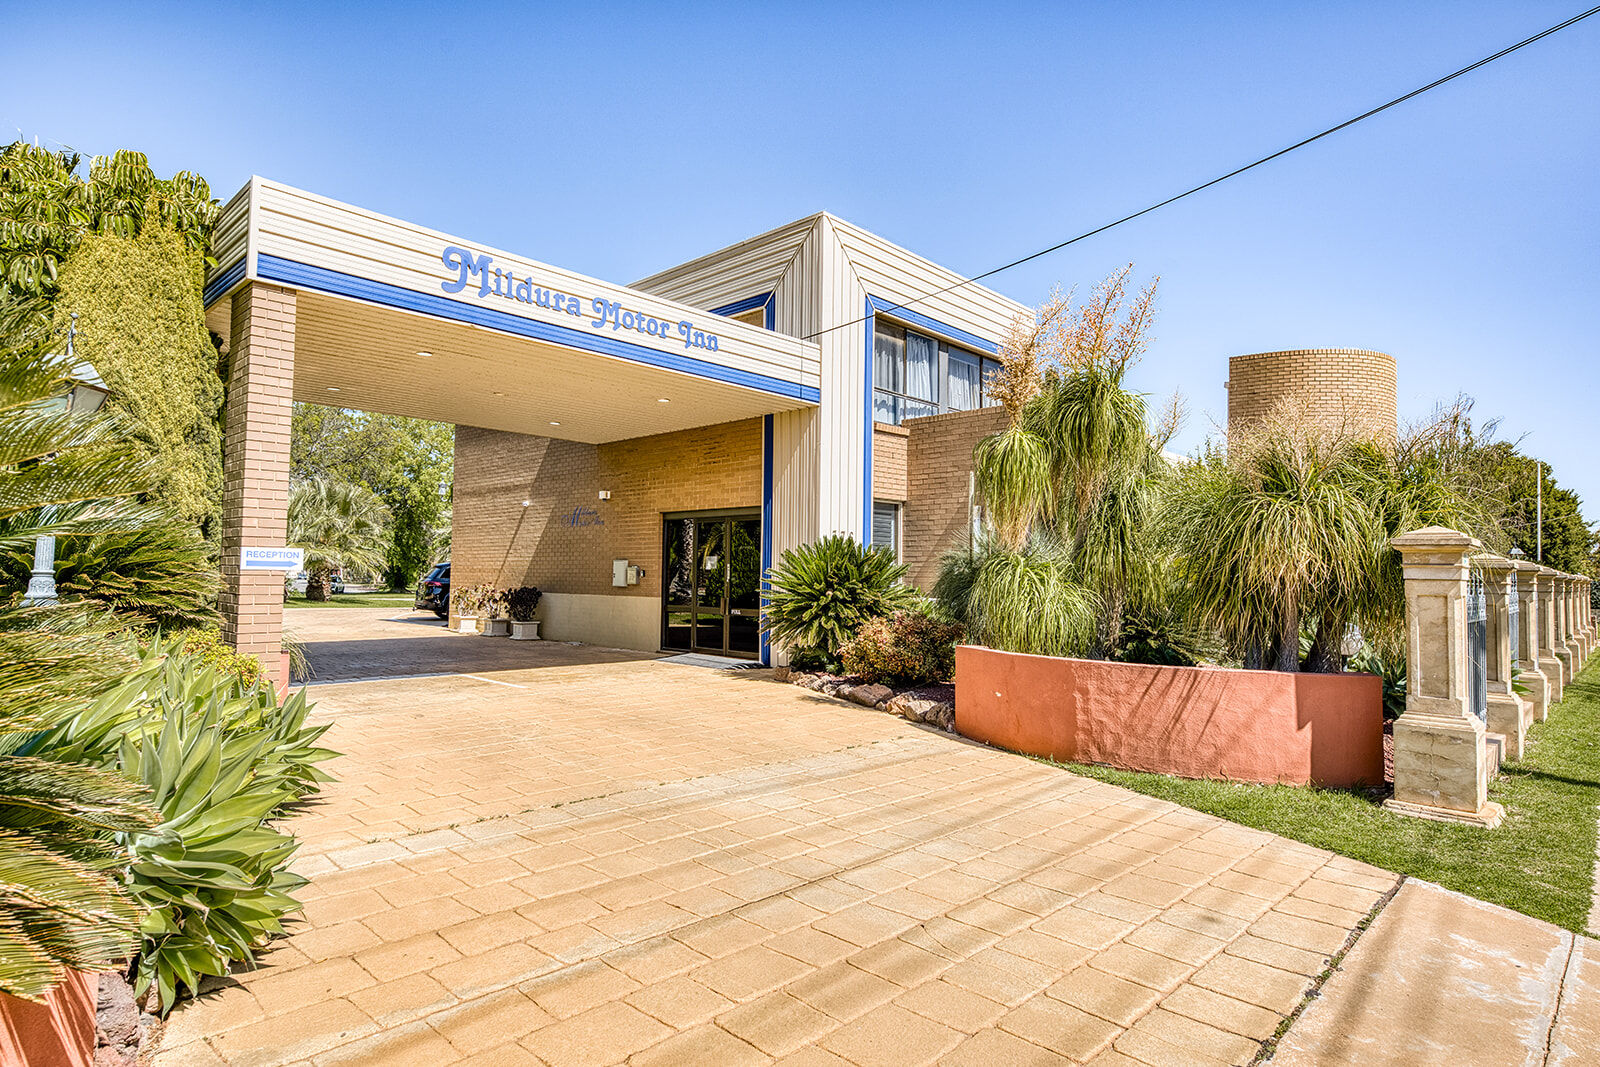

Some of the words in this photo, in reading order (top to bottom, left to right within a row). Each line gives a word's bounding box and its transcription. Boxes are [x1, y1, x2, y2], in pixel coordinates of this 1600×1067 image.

[441, 246, 582, 317] Mildura
[591, 297, 670, 339] Motor
[677, 320, 719, 352] Inn
[246, 550, 300, 559] RECEPTION
